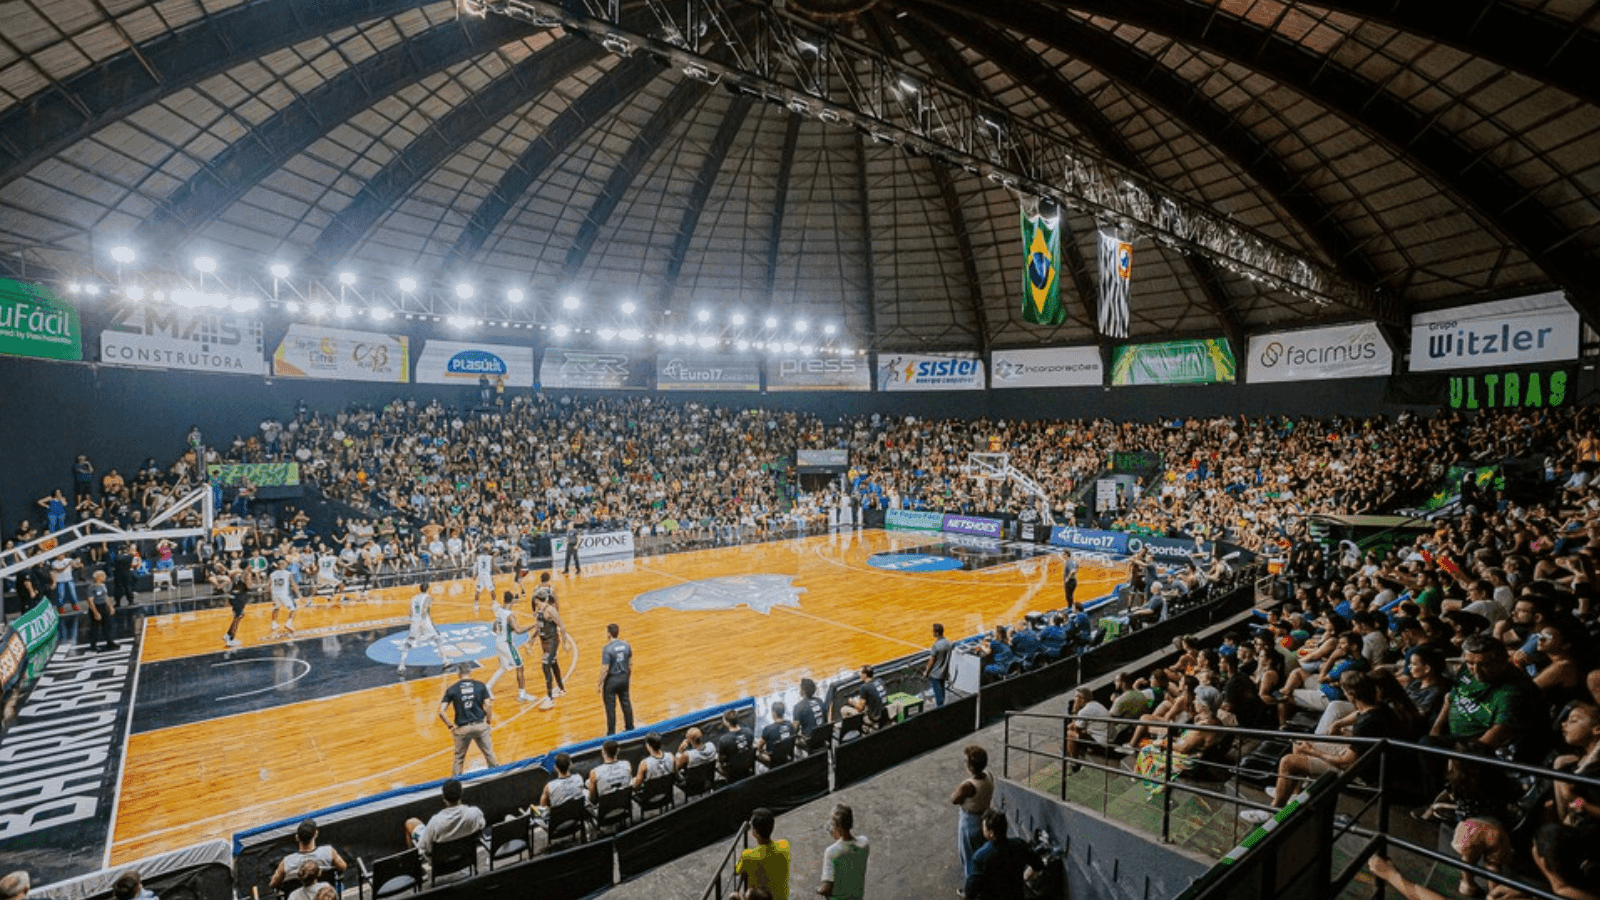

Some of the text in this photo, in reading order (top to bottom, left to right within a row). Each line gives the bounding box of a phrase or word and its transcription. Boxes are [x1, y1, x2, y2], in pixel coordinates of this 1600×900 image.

[1429, 320, 1457, 331] Grupo
[105, 345, 243, 368] CONSTRUTORA
[1287, 342, 1376, 366] facimus
[680, 367, 723, 381] Euro17
[781, 358, 856, 378] press
[1449, 371, 1567, 409] ULTRAS
[947, 519, 998, 533] NETSHOES
[1073, 532, 1115, 548] Euro17
